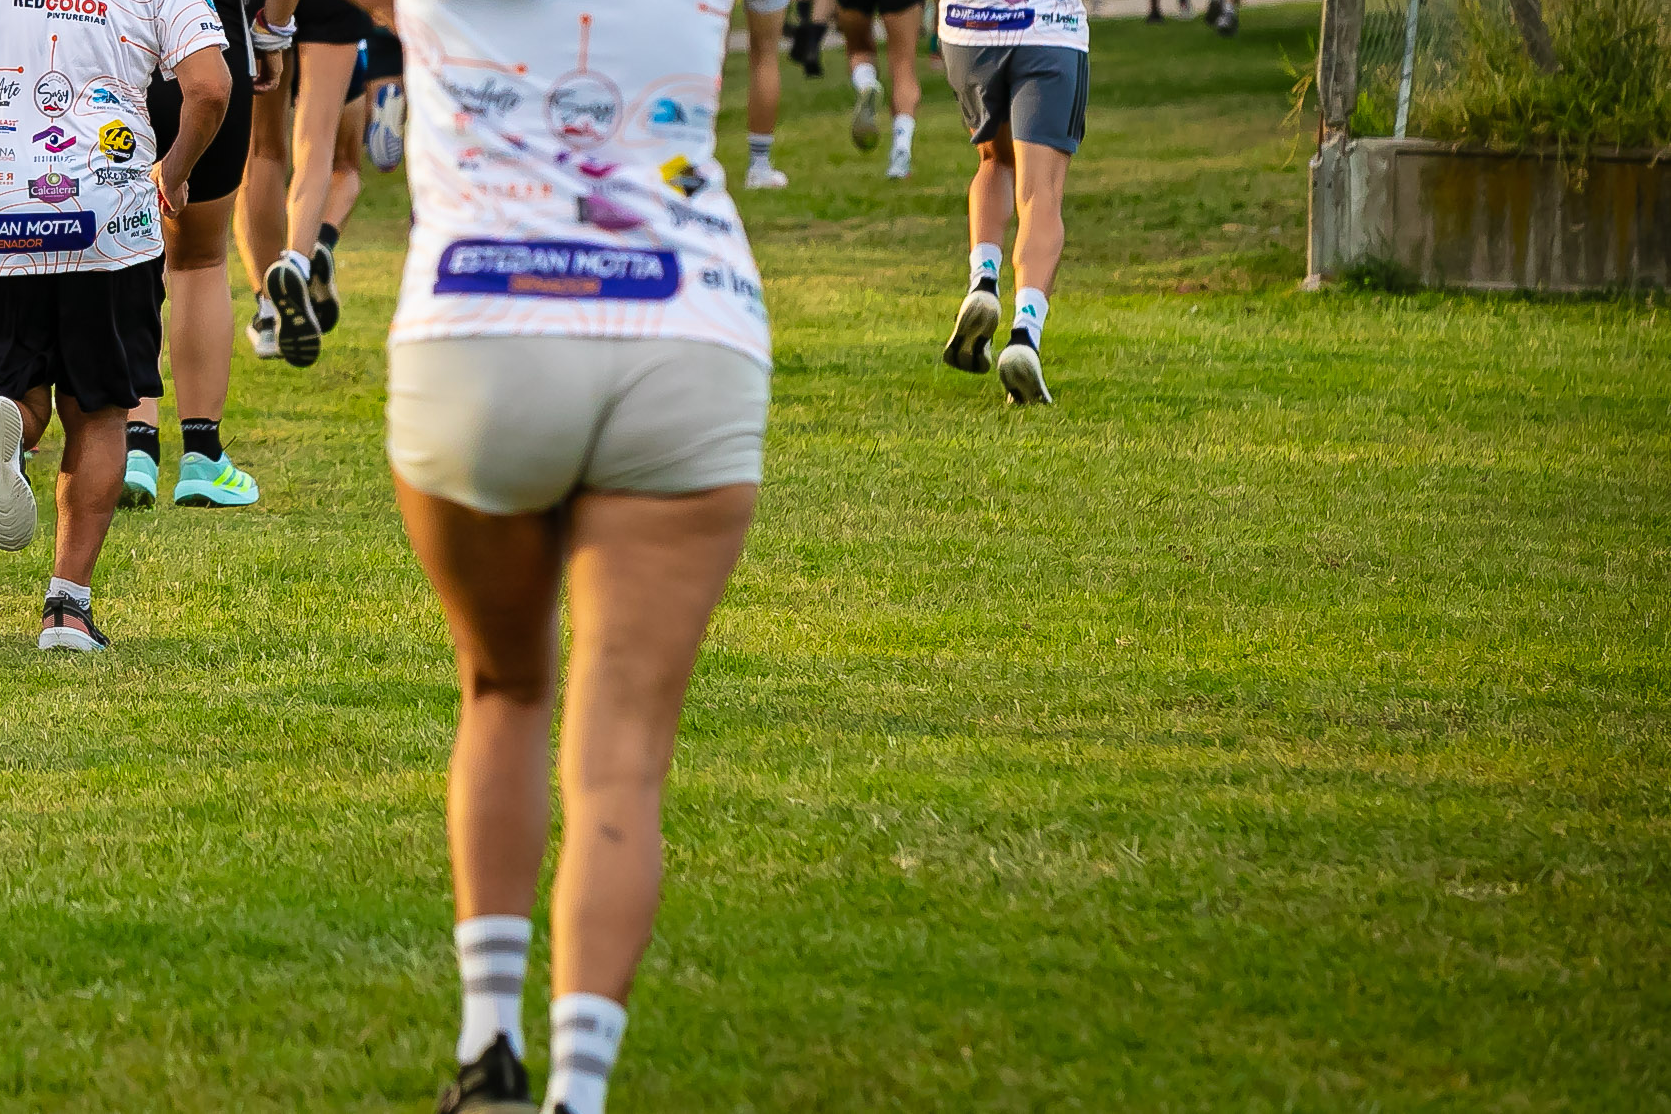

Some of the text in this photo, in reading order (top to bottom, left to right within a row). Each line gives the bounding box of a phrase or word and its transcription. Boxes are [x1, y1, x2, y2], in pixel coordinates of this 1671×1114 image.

[46, 12, 107, 26] PINTURERIAS
[30, 186, 78, 196] Calcaterra
[25, 219, 83, 236] MOTTA
[107, 216, 120, 235] el
